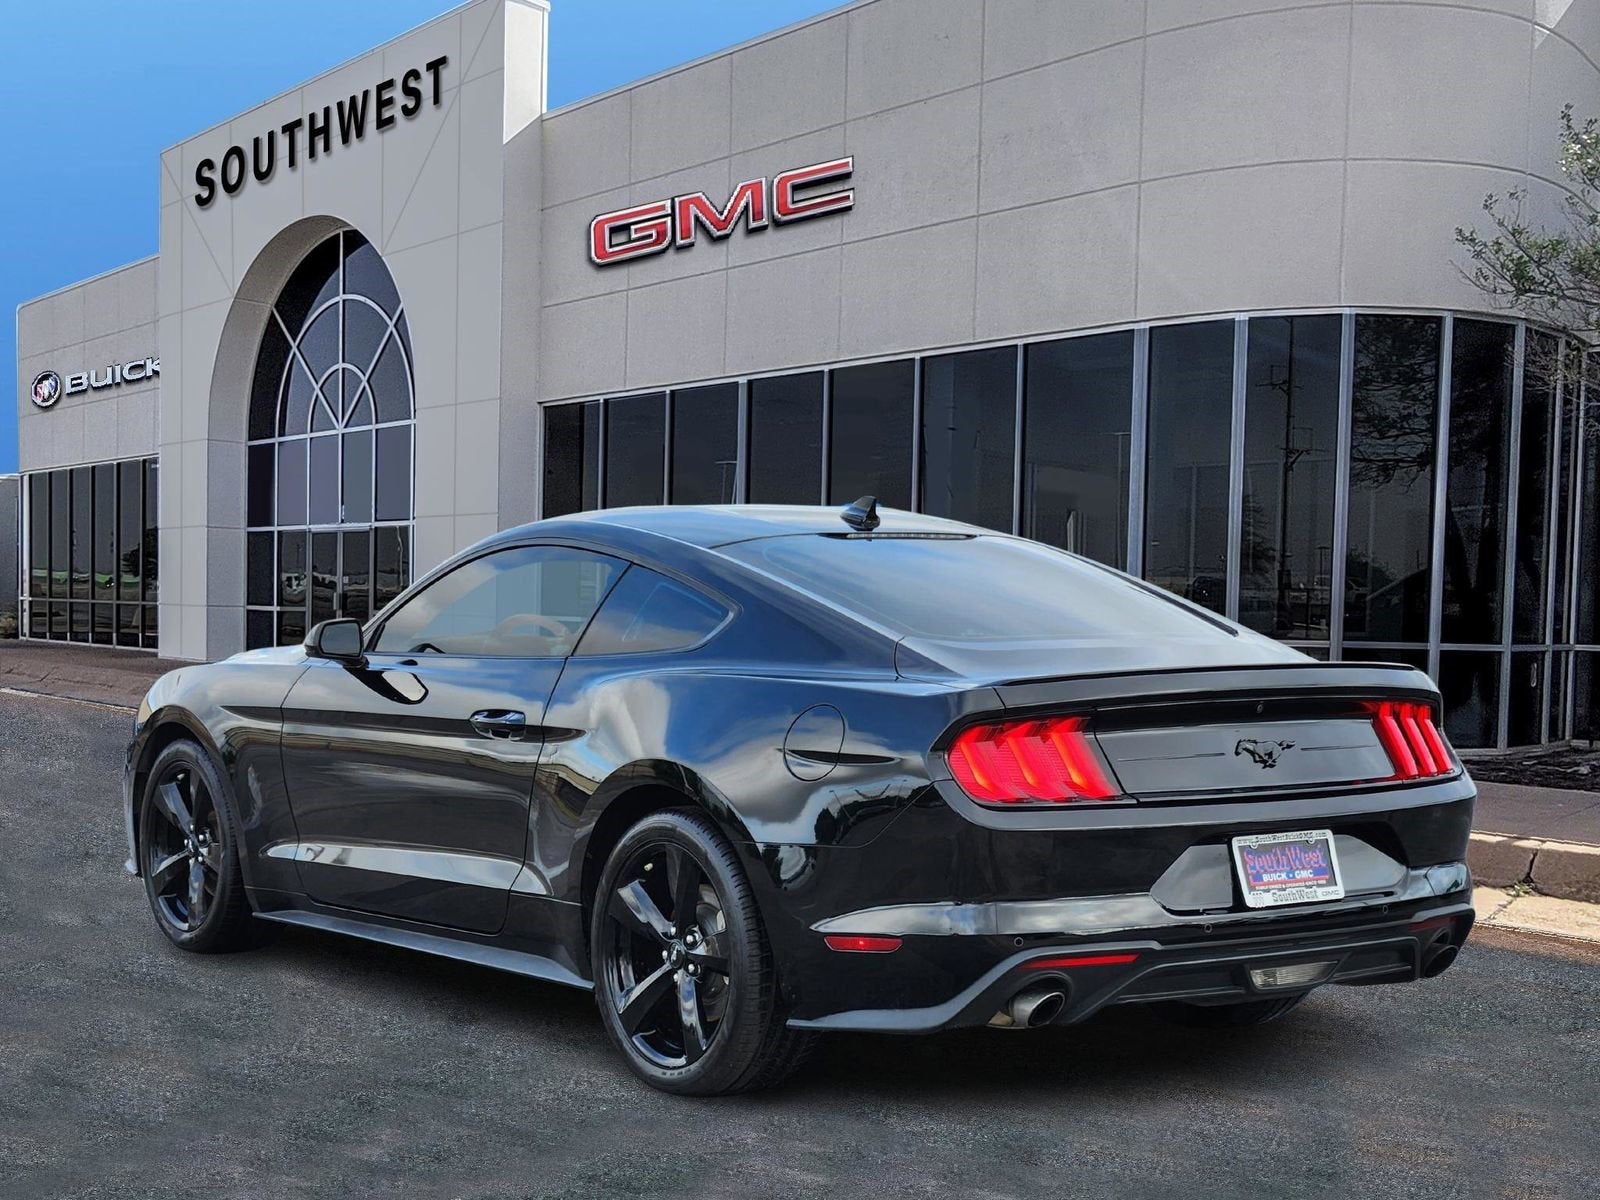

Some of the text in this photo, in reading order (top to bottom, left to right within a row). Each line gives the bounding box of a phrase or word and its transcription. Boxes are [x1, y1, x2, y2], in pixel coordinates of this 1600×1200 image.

[194, 55, 450, 209] SOUTHWEST
[587, 154, 855, 266] GMC
[1262, 869, 1315, 882] BUICK GMC
[1271, 887, 1319, 903] SouthWest
